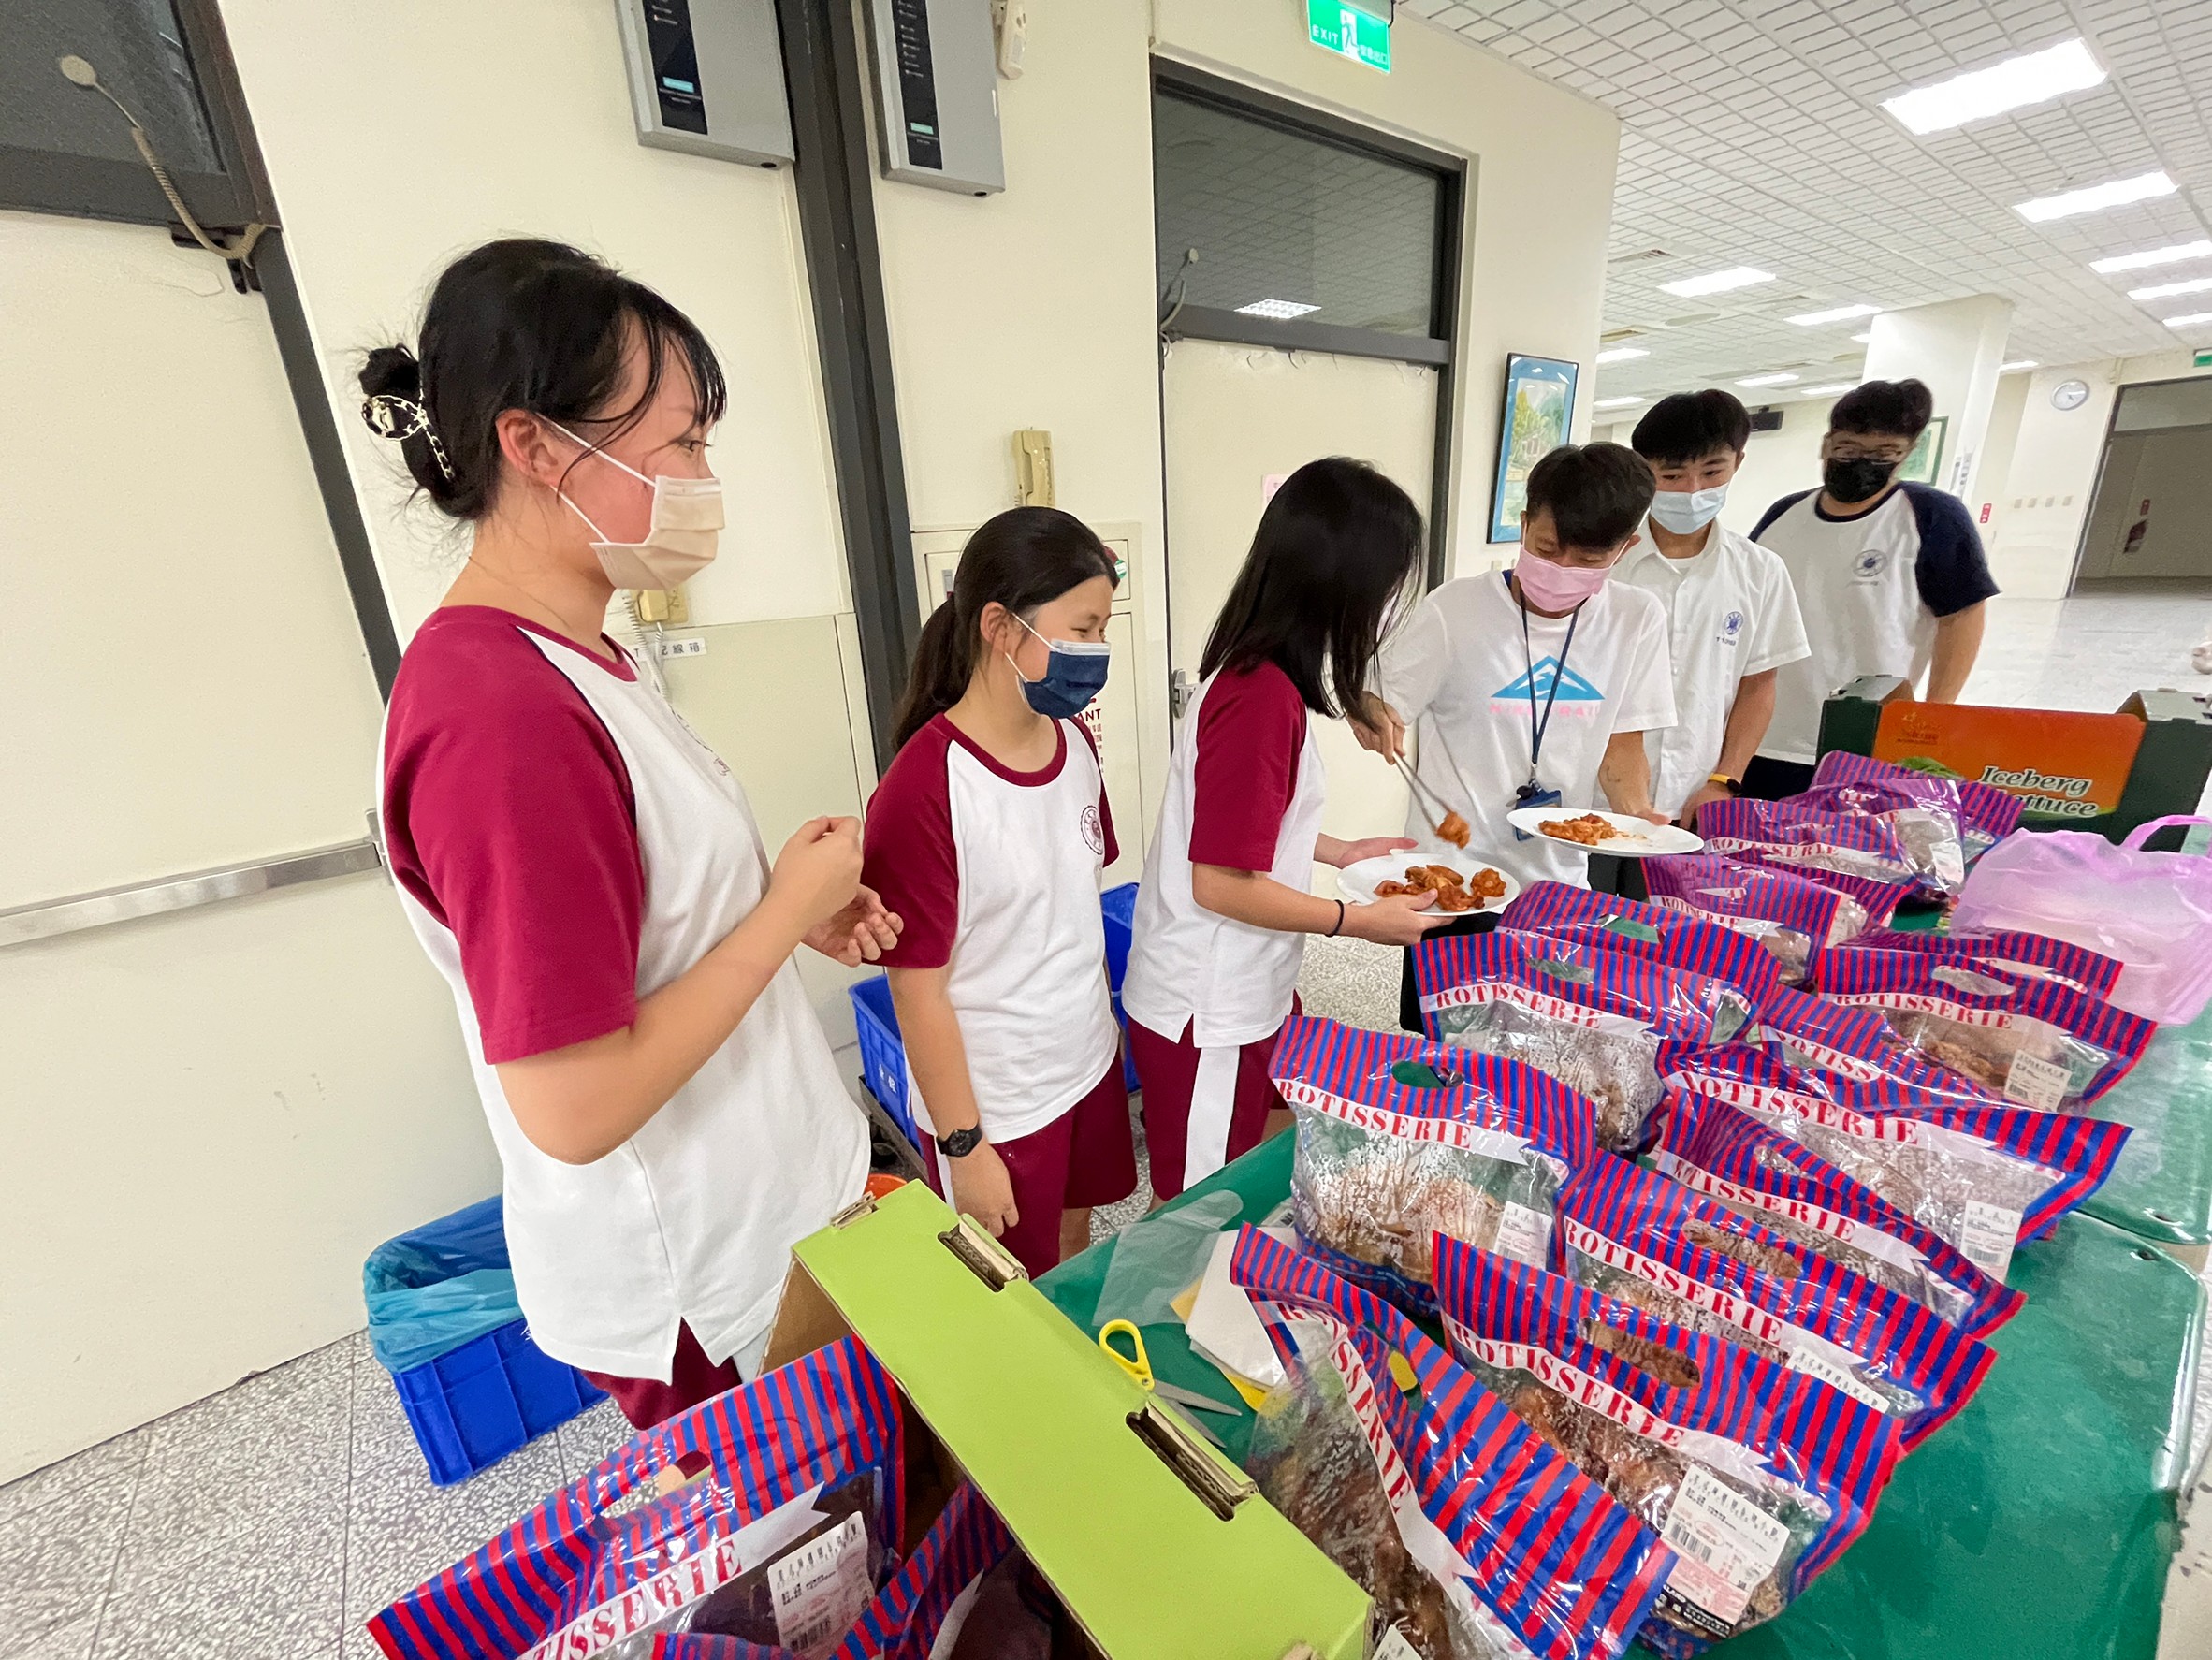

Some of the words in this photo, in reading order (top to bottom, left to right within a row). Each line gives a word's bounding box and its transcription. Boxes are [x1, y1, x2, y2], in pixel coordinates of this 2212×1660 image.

[1312, 24, 1339, 45] EXIT
[1981, 766, 2091, 796] Iceberg
[2012, 793, 2099, 817] ttuce
[1436, 983, 1604, 1028] ROTISSERIE
[1836, 993, 2014, 1029] ROTISSERIE
[1278, 1081, 1473, 1149] ROTISSERIE
[1565, 1218, 1783, 1346] ROTISSERIE
[1452, 1323, 1684, 1448] ROTISSERIE
